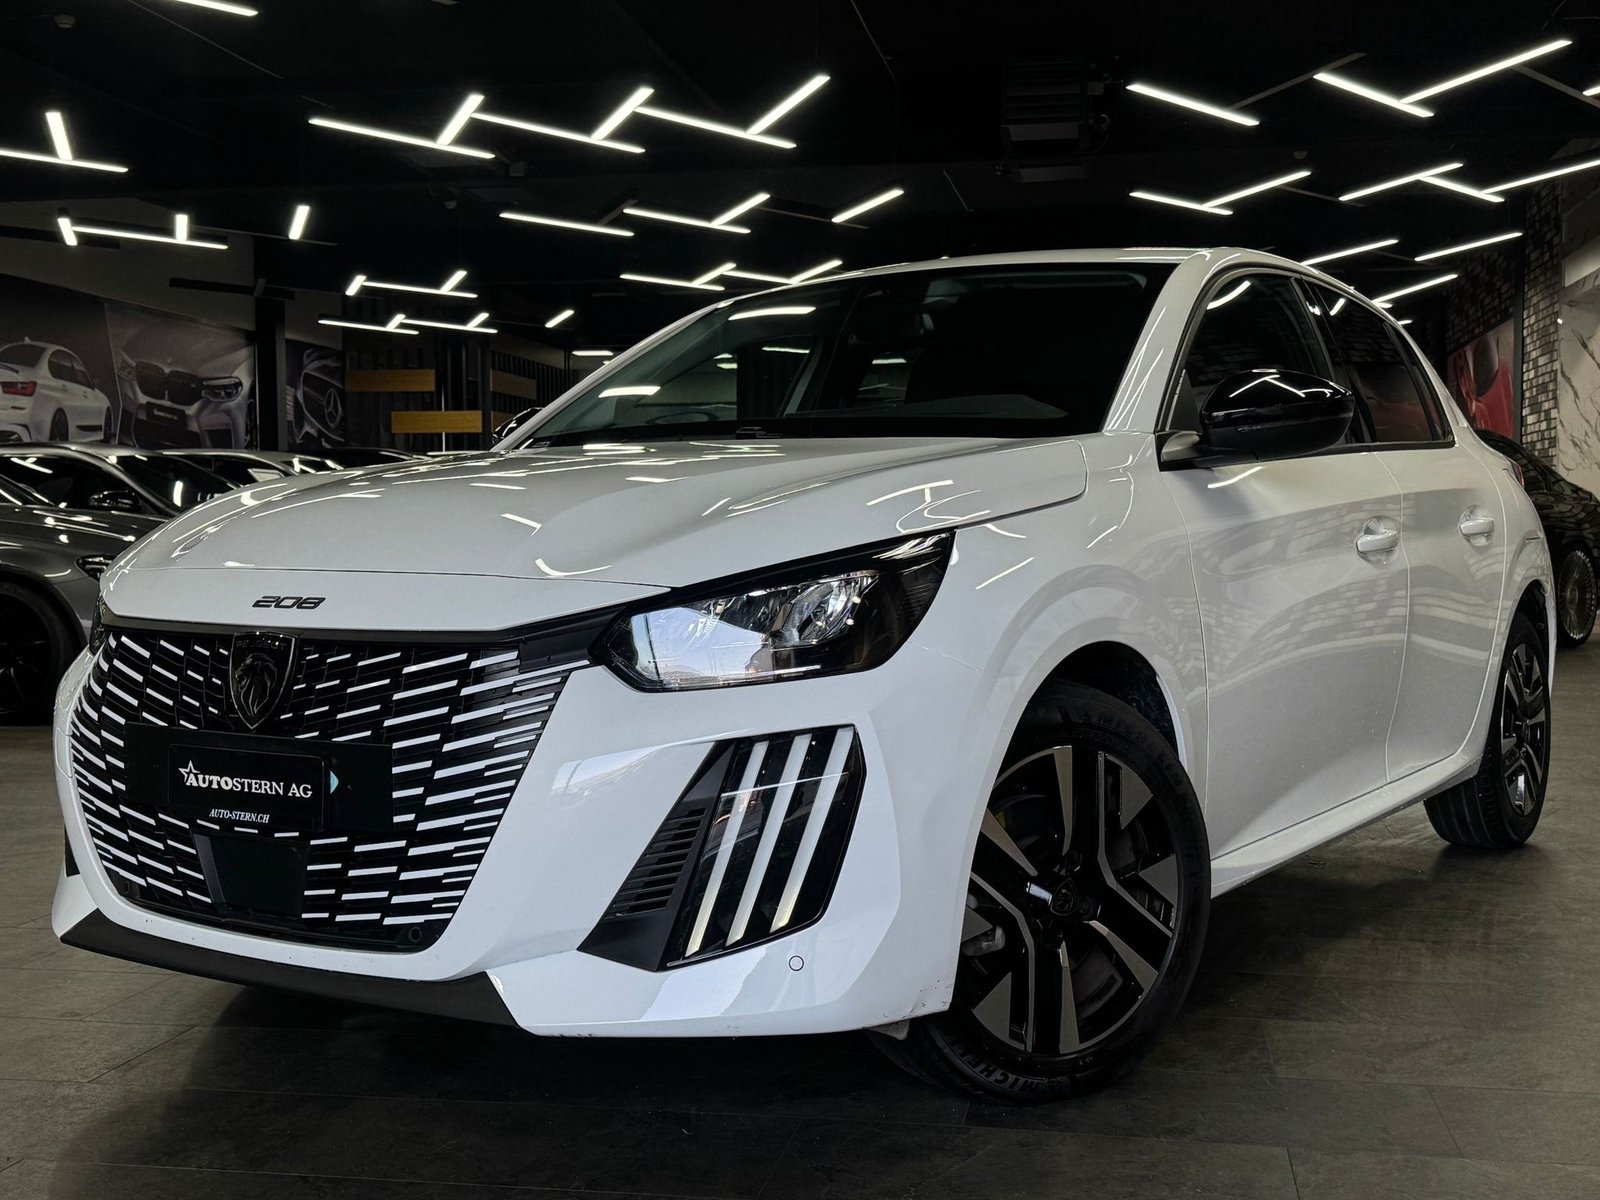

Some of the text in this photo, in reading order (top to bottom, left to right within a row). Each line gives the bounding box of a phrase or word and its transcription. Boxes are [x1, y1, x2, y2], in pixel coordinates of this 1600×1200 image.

[252, 595, 326, 609] 208
[236, 639, 287, 650] PEUGEOT
[185, 772, 313, 798] AUTOSTERN AG
[208, 808, 270, 823] AUTO-STERN.CH
[942, 1028, 1041, 1093] MICHELI
